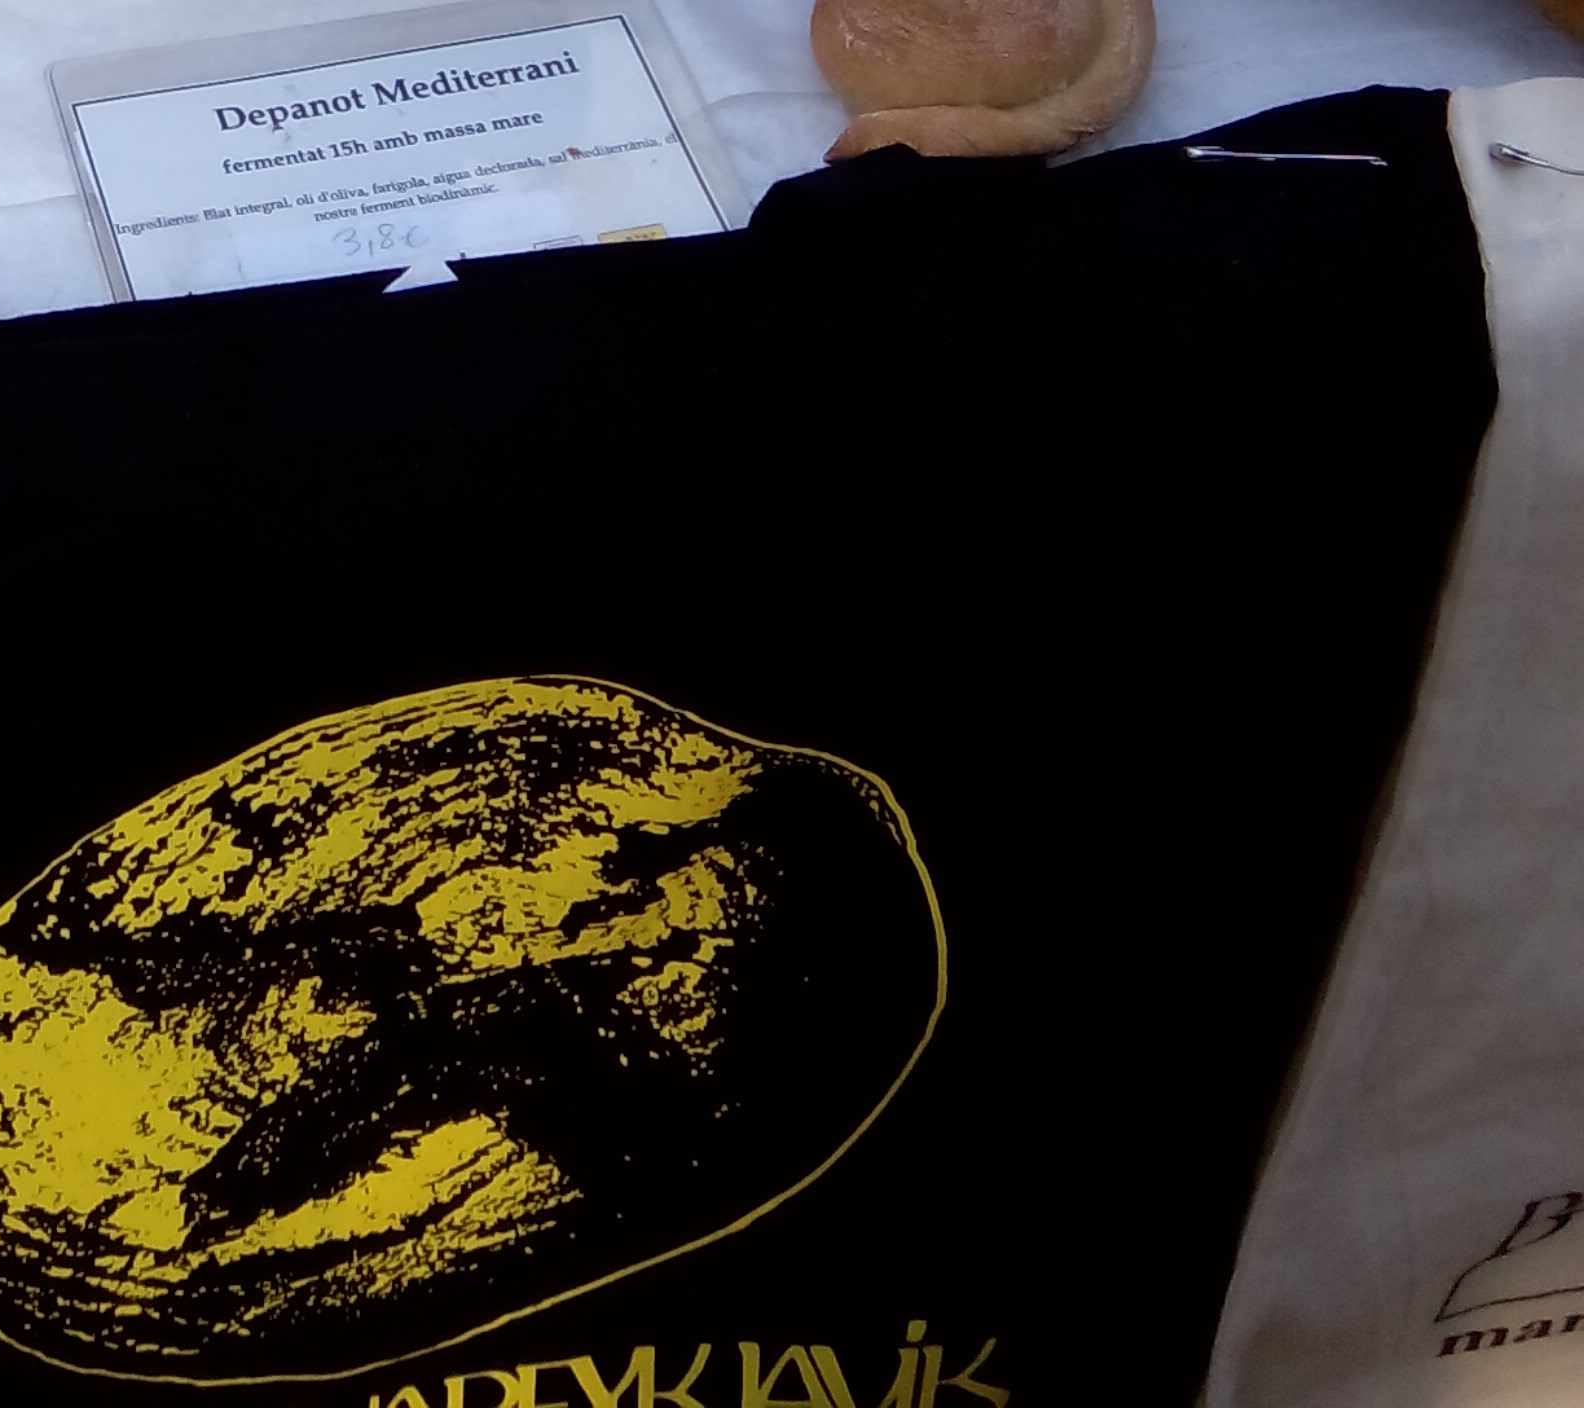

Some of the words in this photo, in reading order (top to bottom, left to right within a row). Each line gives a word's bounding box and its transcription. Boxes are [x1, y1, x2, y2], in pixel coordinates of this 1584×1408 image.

[214, 87, 367, 133] Depanot
[371, 50, 580, 107] Mediterrani
[222, 147, 327, 176] fermentat
[329, 139, 369, 159] 15h
[373, 131, 419, 151] amb
[424, 122, 488, 144] massa
[491, 111, 545, 132] mare
[296, 192, 316, 208] oli
